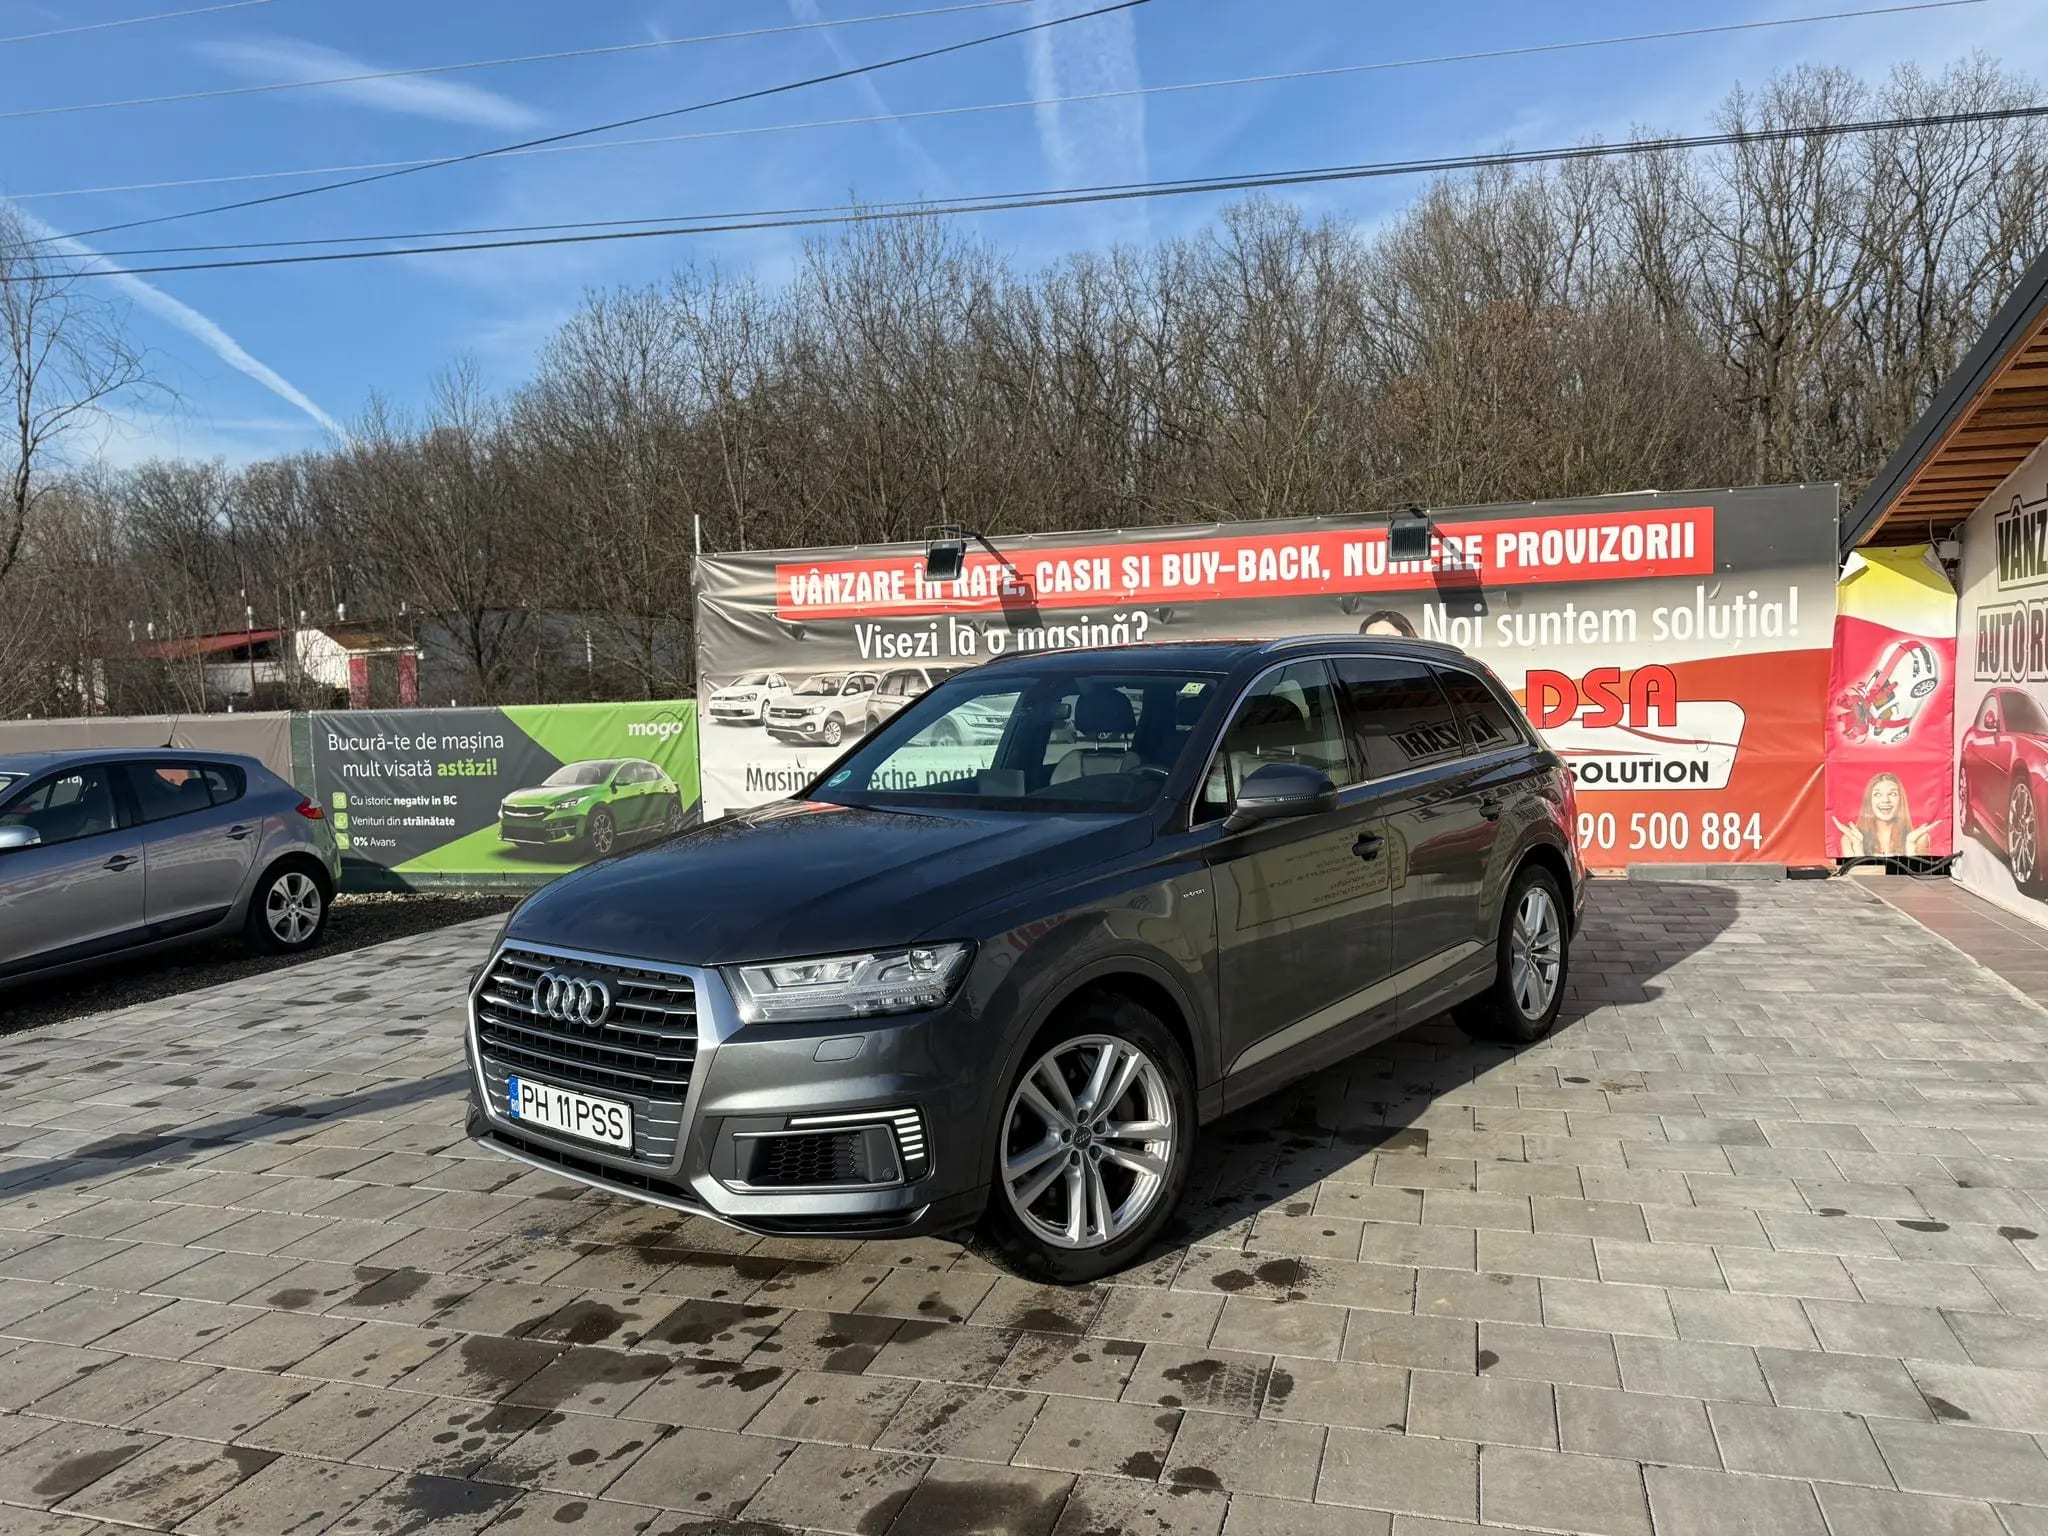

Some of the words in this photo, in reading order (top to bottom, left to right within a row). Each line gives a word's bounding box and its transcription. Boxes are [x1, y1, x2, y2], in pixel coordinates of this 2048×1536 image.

[790, 568, 906, 605] VÂNZARE
[952, 563, 1026, 598] RATE,
[1036, 557, 1111, 593] CASH
[1121, 555, 1151, 597] ȘI
[1162, 545, 1331, 587] BUY-BACK,
[1496, 521, 1695, 569] PROVIZORII
[1423, 602, 1483, 649] Noi
[1497, 603, 1638, 646] suntem
[1652, 585, 1799, 649] soluția!
[854, 622, 938, 660] Visezi
[949, 616, 976, 656] la
[987, 630, 1006, 655] o
[1526, 664, 1677, 730] DSA
[327, 733, 411, 751] Bucură-te
[415, 732, 437, 750] de
[442, 731, 504, 753] mașina
[628, 721, 683, 743] mogo
[343, 760, 382, 777] mult
[384, 759, 433, 777] visată
[437, 758, 498, 777] astăzi!
[350, 795, 364, 806] Cu
[365, 795, 392, 806] istoric
[393, 795, 430, 808] negativ
[443, 795, 458, 806] BC
[351, 816, 385, 827] Venituri
[387, 815, 401, 827] din
[1629, 811, 1689, 850] 500
[1701, 811, 1763, 850] 884
[353, 837, 368, 847] 0%
[370, 837, 396, 847] Avans
[522, 1084, 549, 1121] PH
